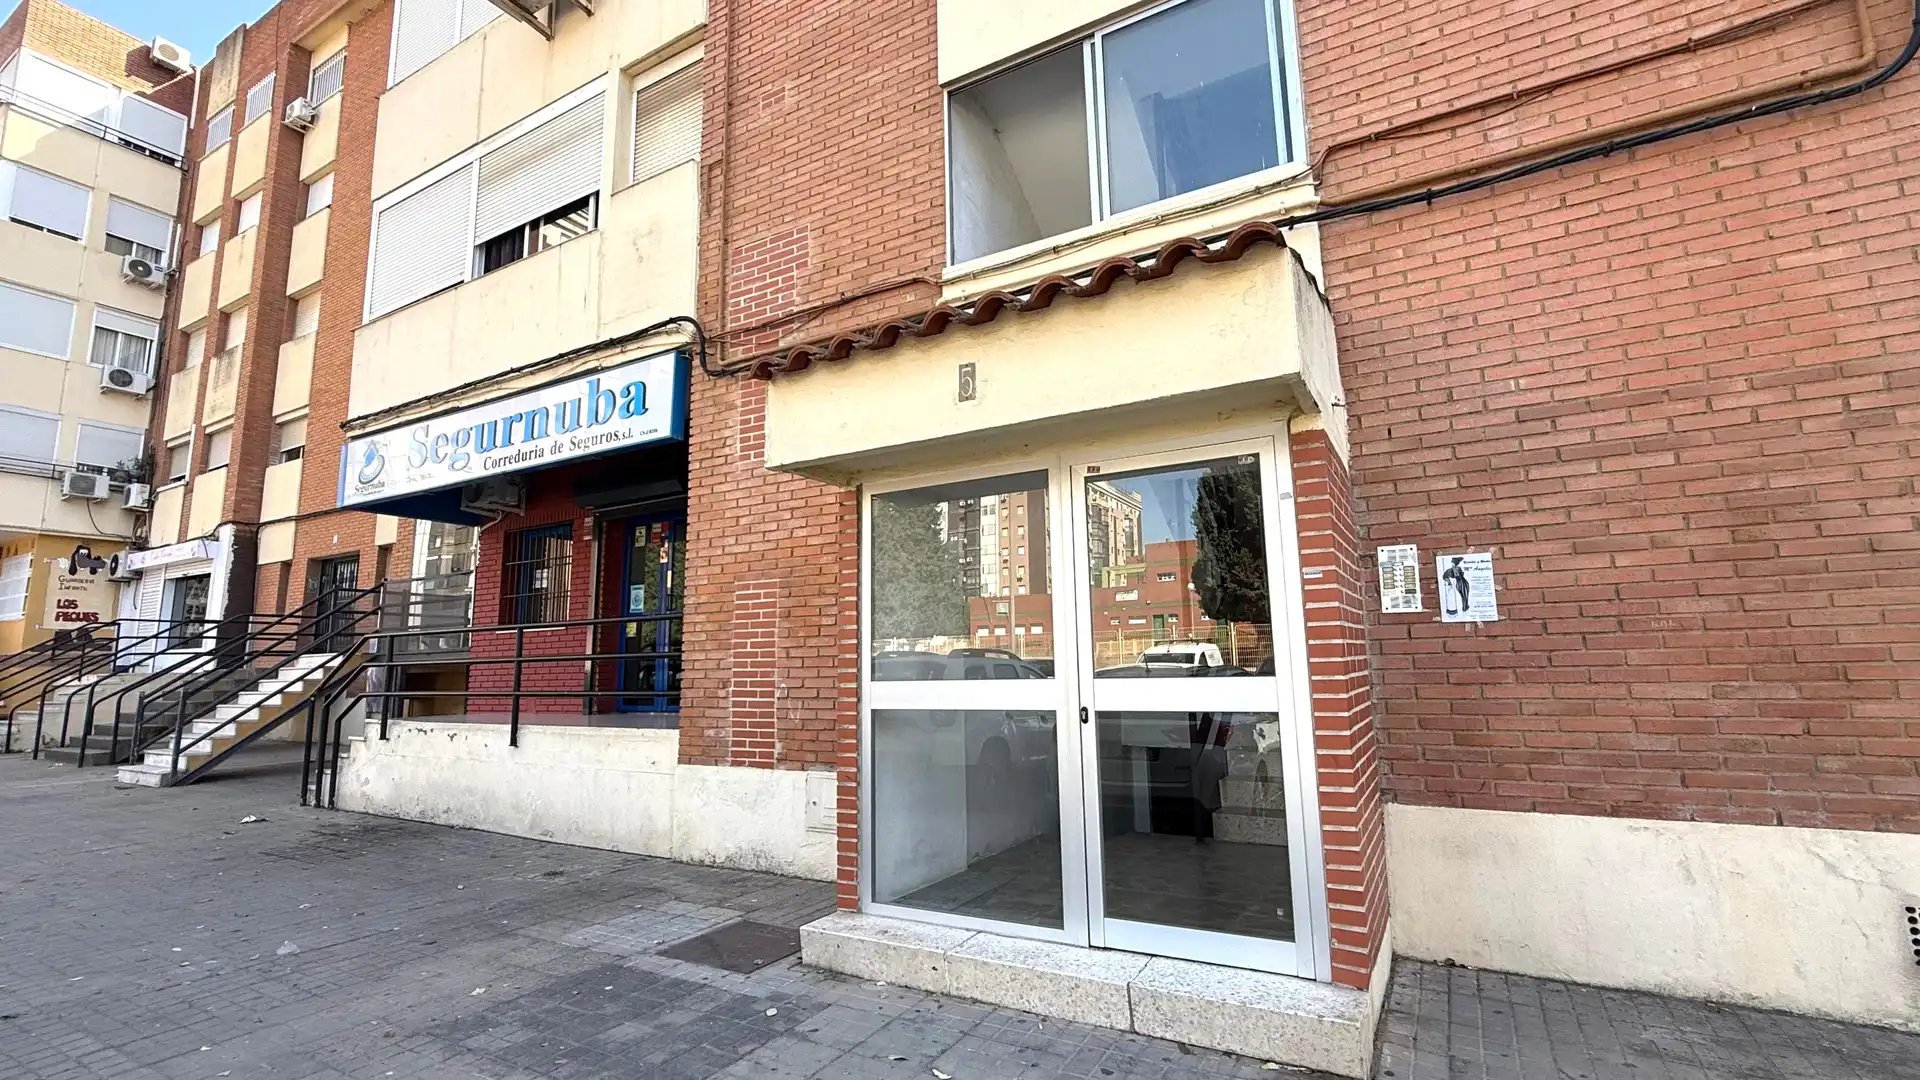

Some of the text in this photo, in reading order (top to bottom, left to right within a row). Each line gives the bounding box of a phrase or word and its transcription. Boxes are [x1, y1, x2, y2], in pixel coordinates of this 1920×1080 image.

[961, 367, 973, 397] 5
[408, 378, 649, 472] Segurnuba
[483, 448, 545, 471] Correduria
[550, 440, 564, 455] de
[55, 611, 99, 622] PEQUES
[57, 599, 79, 609] LOS
